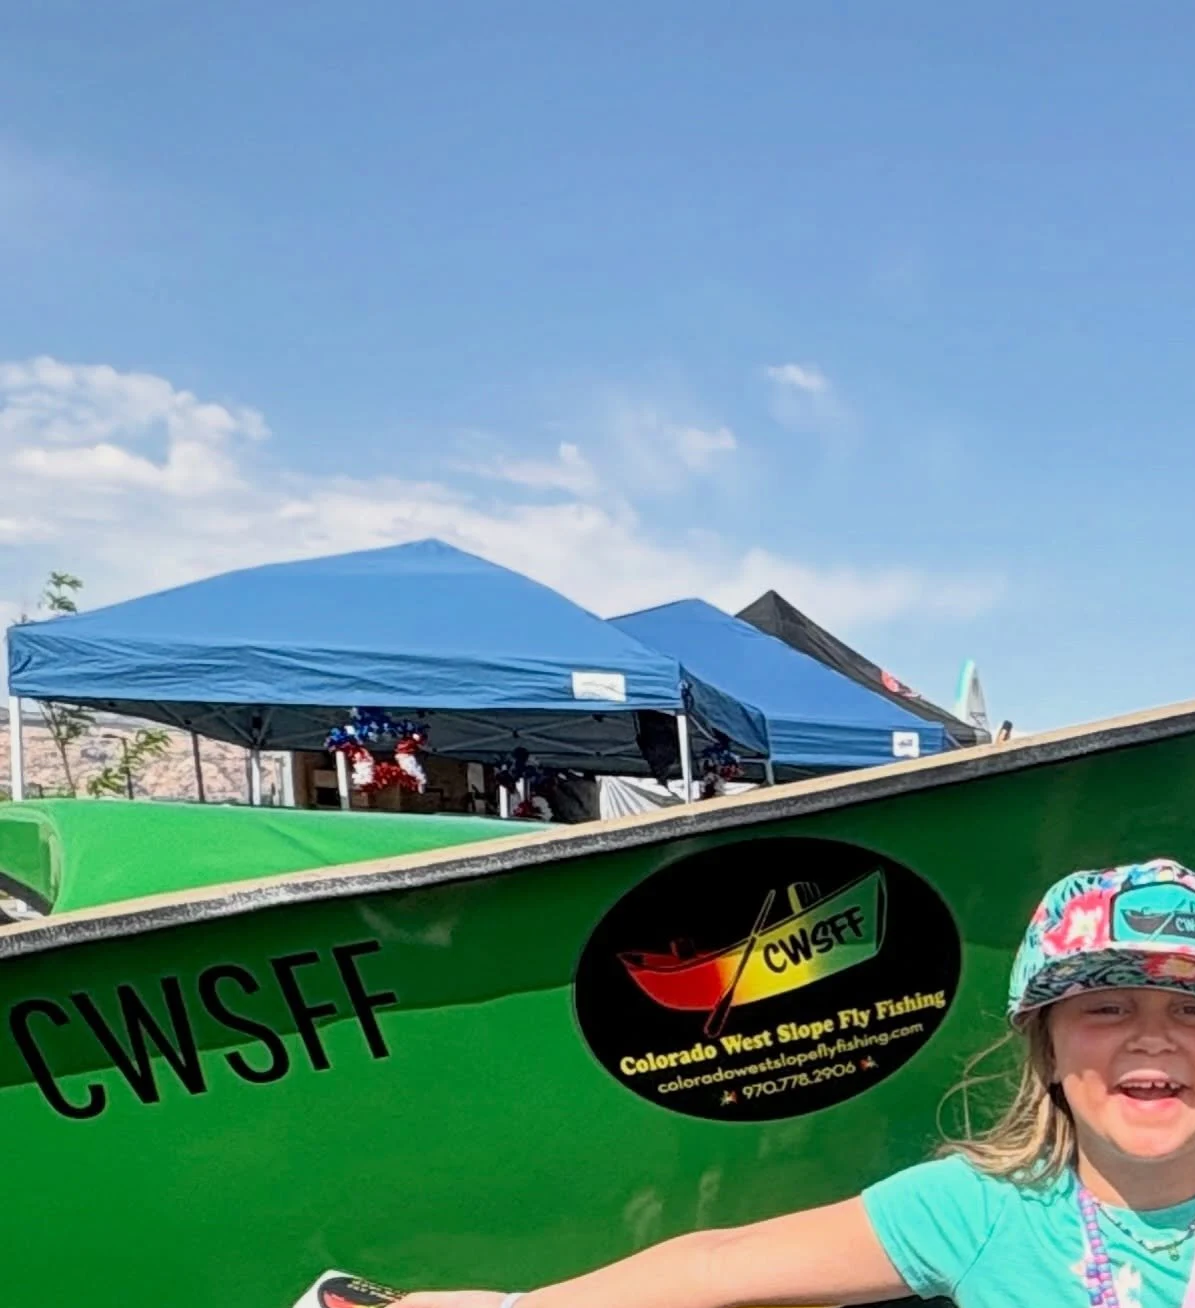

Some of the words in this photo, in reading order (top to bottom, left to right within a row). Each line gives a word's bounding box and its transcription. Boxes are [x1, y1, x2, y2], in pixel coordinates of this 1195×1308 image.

[764, 905, 865, 973] CWSFF
[8, 940, 398, 1120] CWSFF
[620, 1043, 717, 1076] Colorado
[720, 1030, 773, 1055] West
[777, 1019, 834, 1043] Slope
[837, 1008, 870, 1028] Fly
[875, 990, 946, 1020] Fishing
[657, 1022, 924, 1093] coloradowestslopeflyfishing.com
[742, 1061, 856, 1099] 970.778.2906
